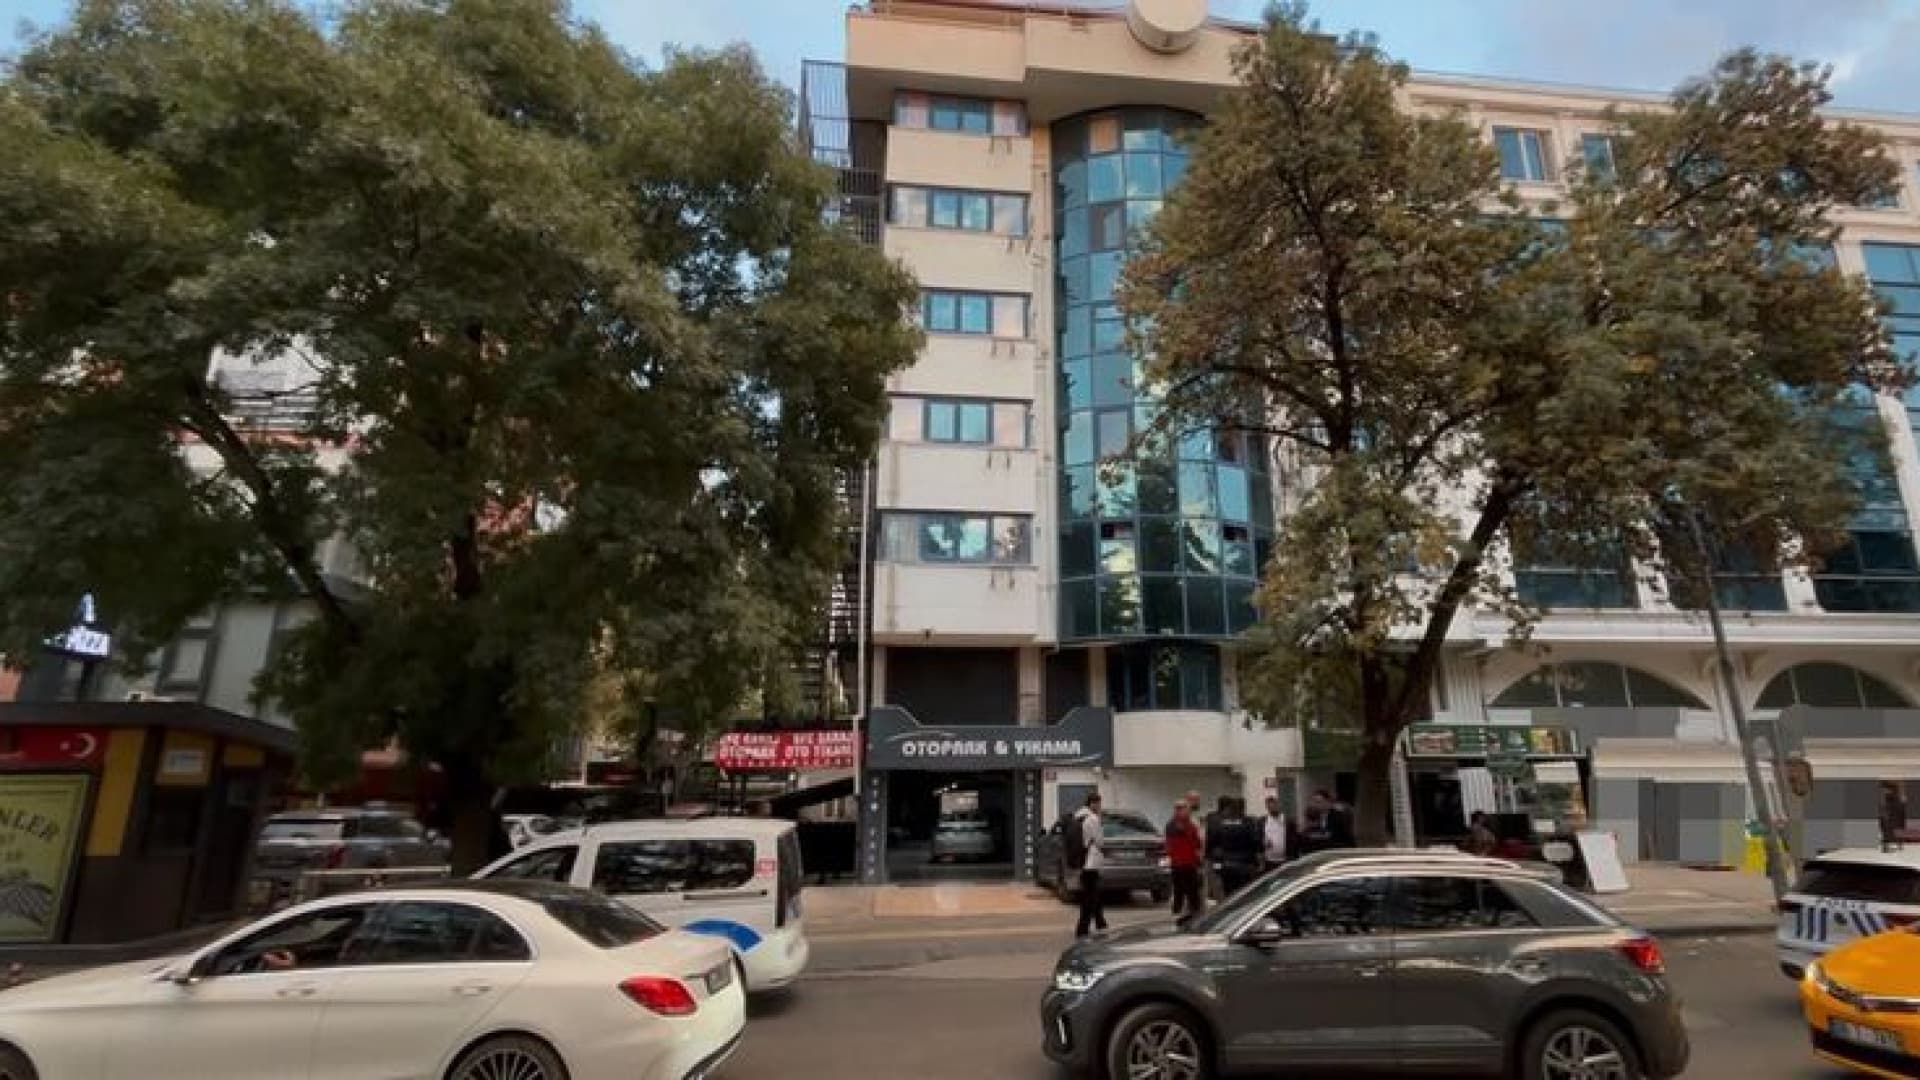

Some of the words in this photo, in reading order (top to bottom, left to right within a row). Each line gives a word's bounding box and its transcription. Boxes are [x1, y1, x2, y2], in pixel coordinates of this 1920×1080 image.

[901, 740, 987, 757] OTOPARK
[994, 741, 1008, 755] &
[1014, 740, 1081, 755] YIKAMA
